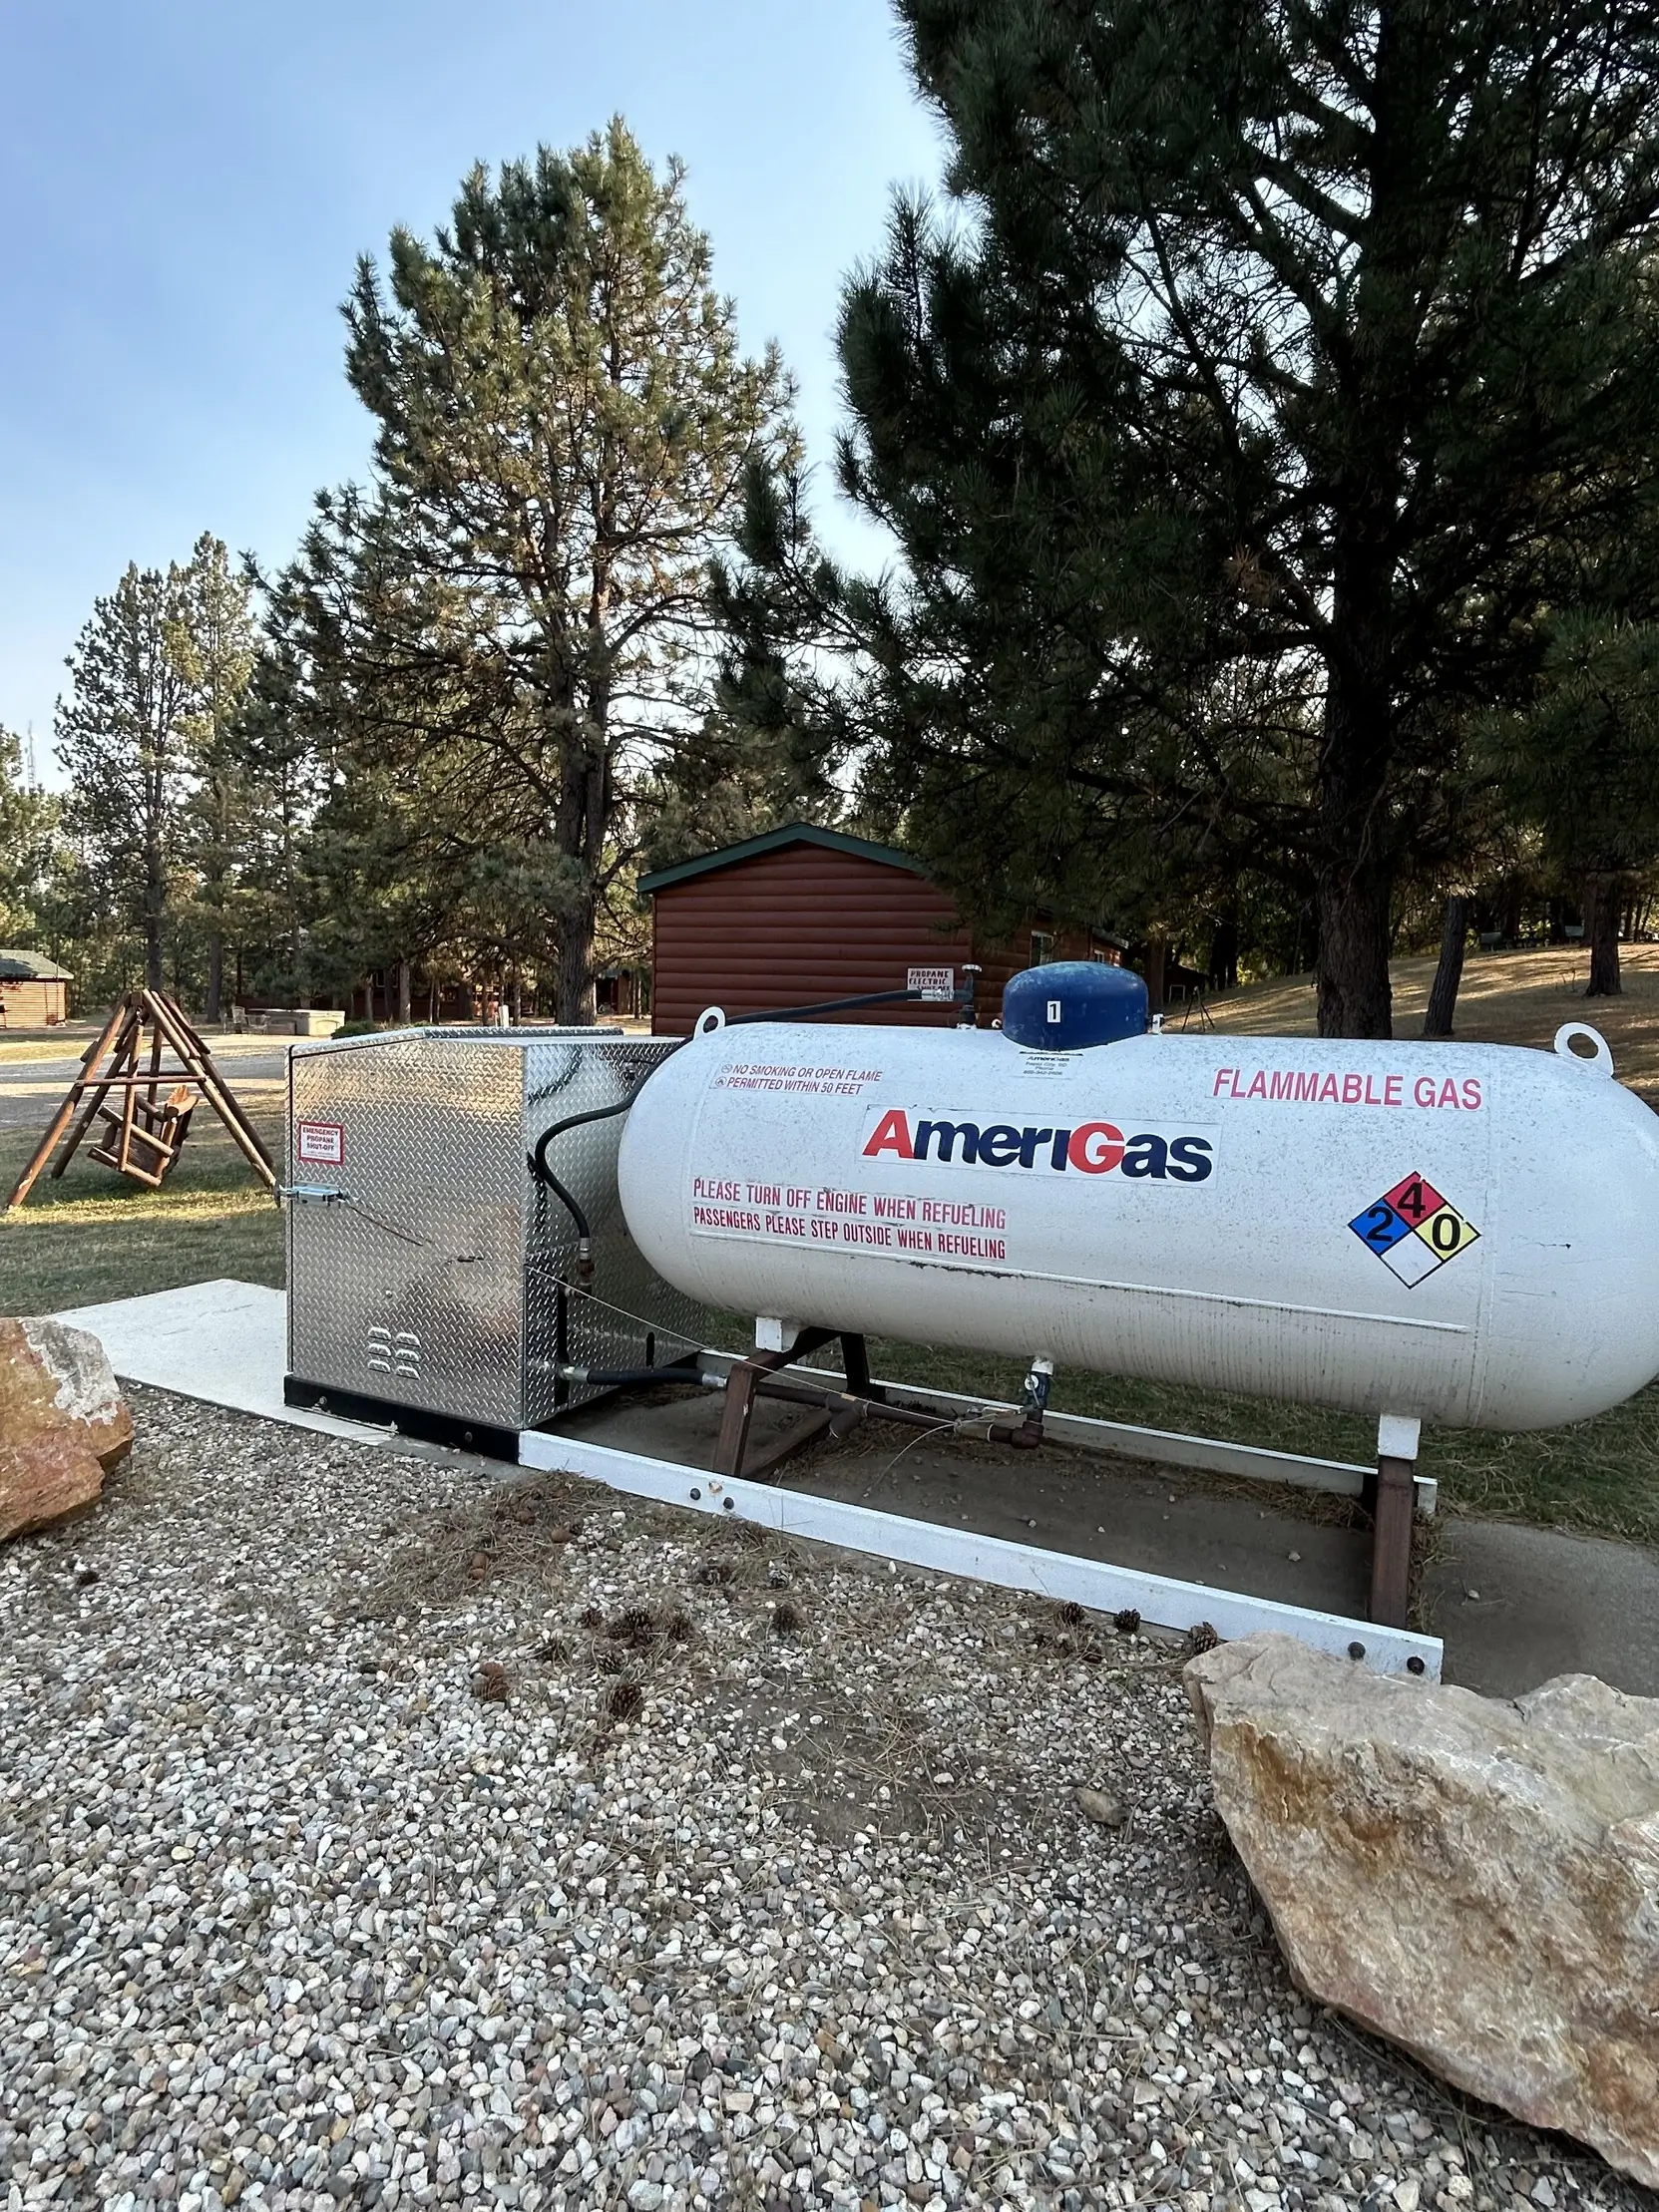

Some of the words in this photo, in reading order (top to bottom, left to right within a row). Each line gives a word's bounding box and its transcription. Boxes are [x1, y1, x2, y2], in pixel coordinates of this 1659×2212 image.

[1049, 1003, 1057, 1020] 1
[726, 1077, 783, 1090] PERMITTED
[784, 1080, 819, 1093] WITHIN
[821, 1082, 833, 1093] 50
[835, 1083, 863, 1095] FEET
[732, 1064, 748, 1075] NO
[749, 1065, 796, 1077] SMOKING
[798, 1067, 813, 1078] OR
[815, 1068, 845, 1079] OPEN
[846, 1070, 883, 1082] FLAME
[1213, 1068, 1404, 1106] FLAMMABLE
[1414, 1077, 1483, 1111] GAS
[302, 1127, 339, 1136] EMERGENCY
[306, 1135, 334, 1144] PROPANE
[862, 1110, 1213, 1182] AmeriGas
[693, 1178, 741, 1202] PLEASE
[746, 1185, 781, 1207] TURN
[786, 1188, 812, 1209] OFF
[817, 1191, 867, 1215] ENGINE
[874, 1197, 916, 1220] WHEN
[923, 1201, 1006, 1230] REFUELING
[1397, 1182, 1427, 1219] 4
[693, 1207, 761, 1231] PASSENGERS
[765, 1215, 806, 1237] PLEASE
[810, 1219, 839, 1241] STEP
[843, 1223, 892, 1247] OUTSIDE
[898, 1229, 932, 1251] WHEN
[938, 1233, 1006, 1260] REFUELING
[1366, 1206, 1394, 1243] 2
[1432, 1213, 1461, 1251] 0
